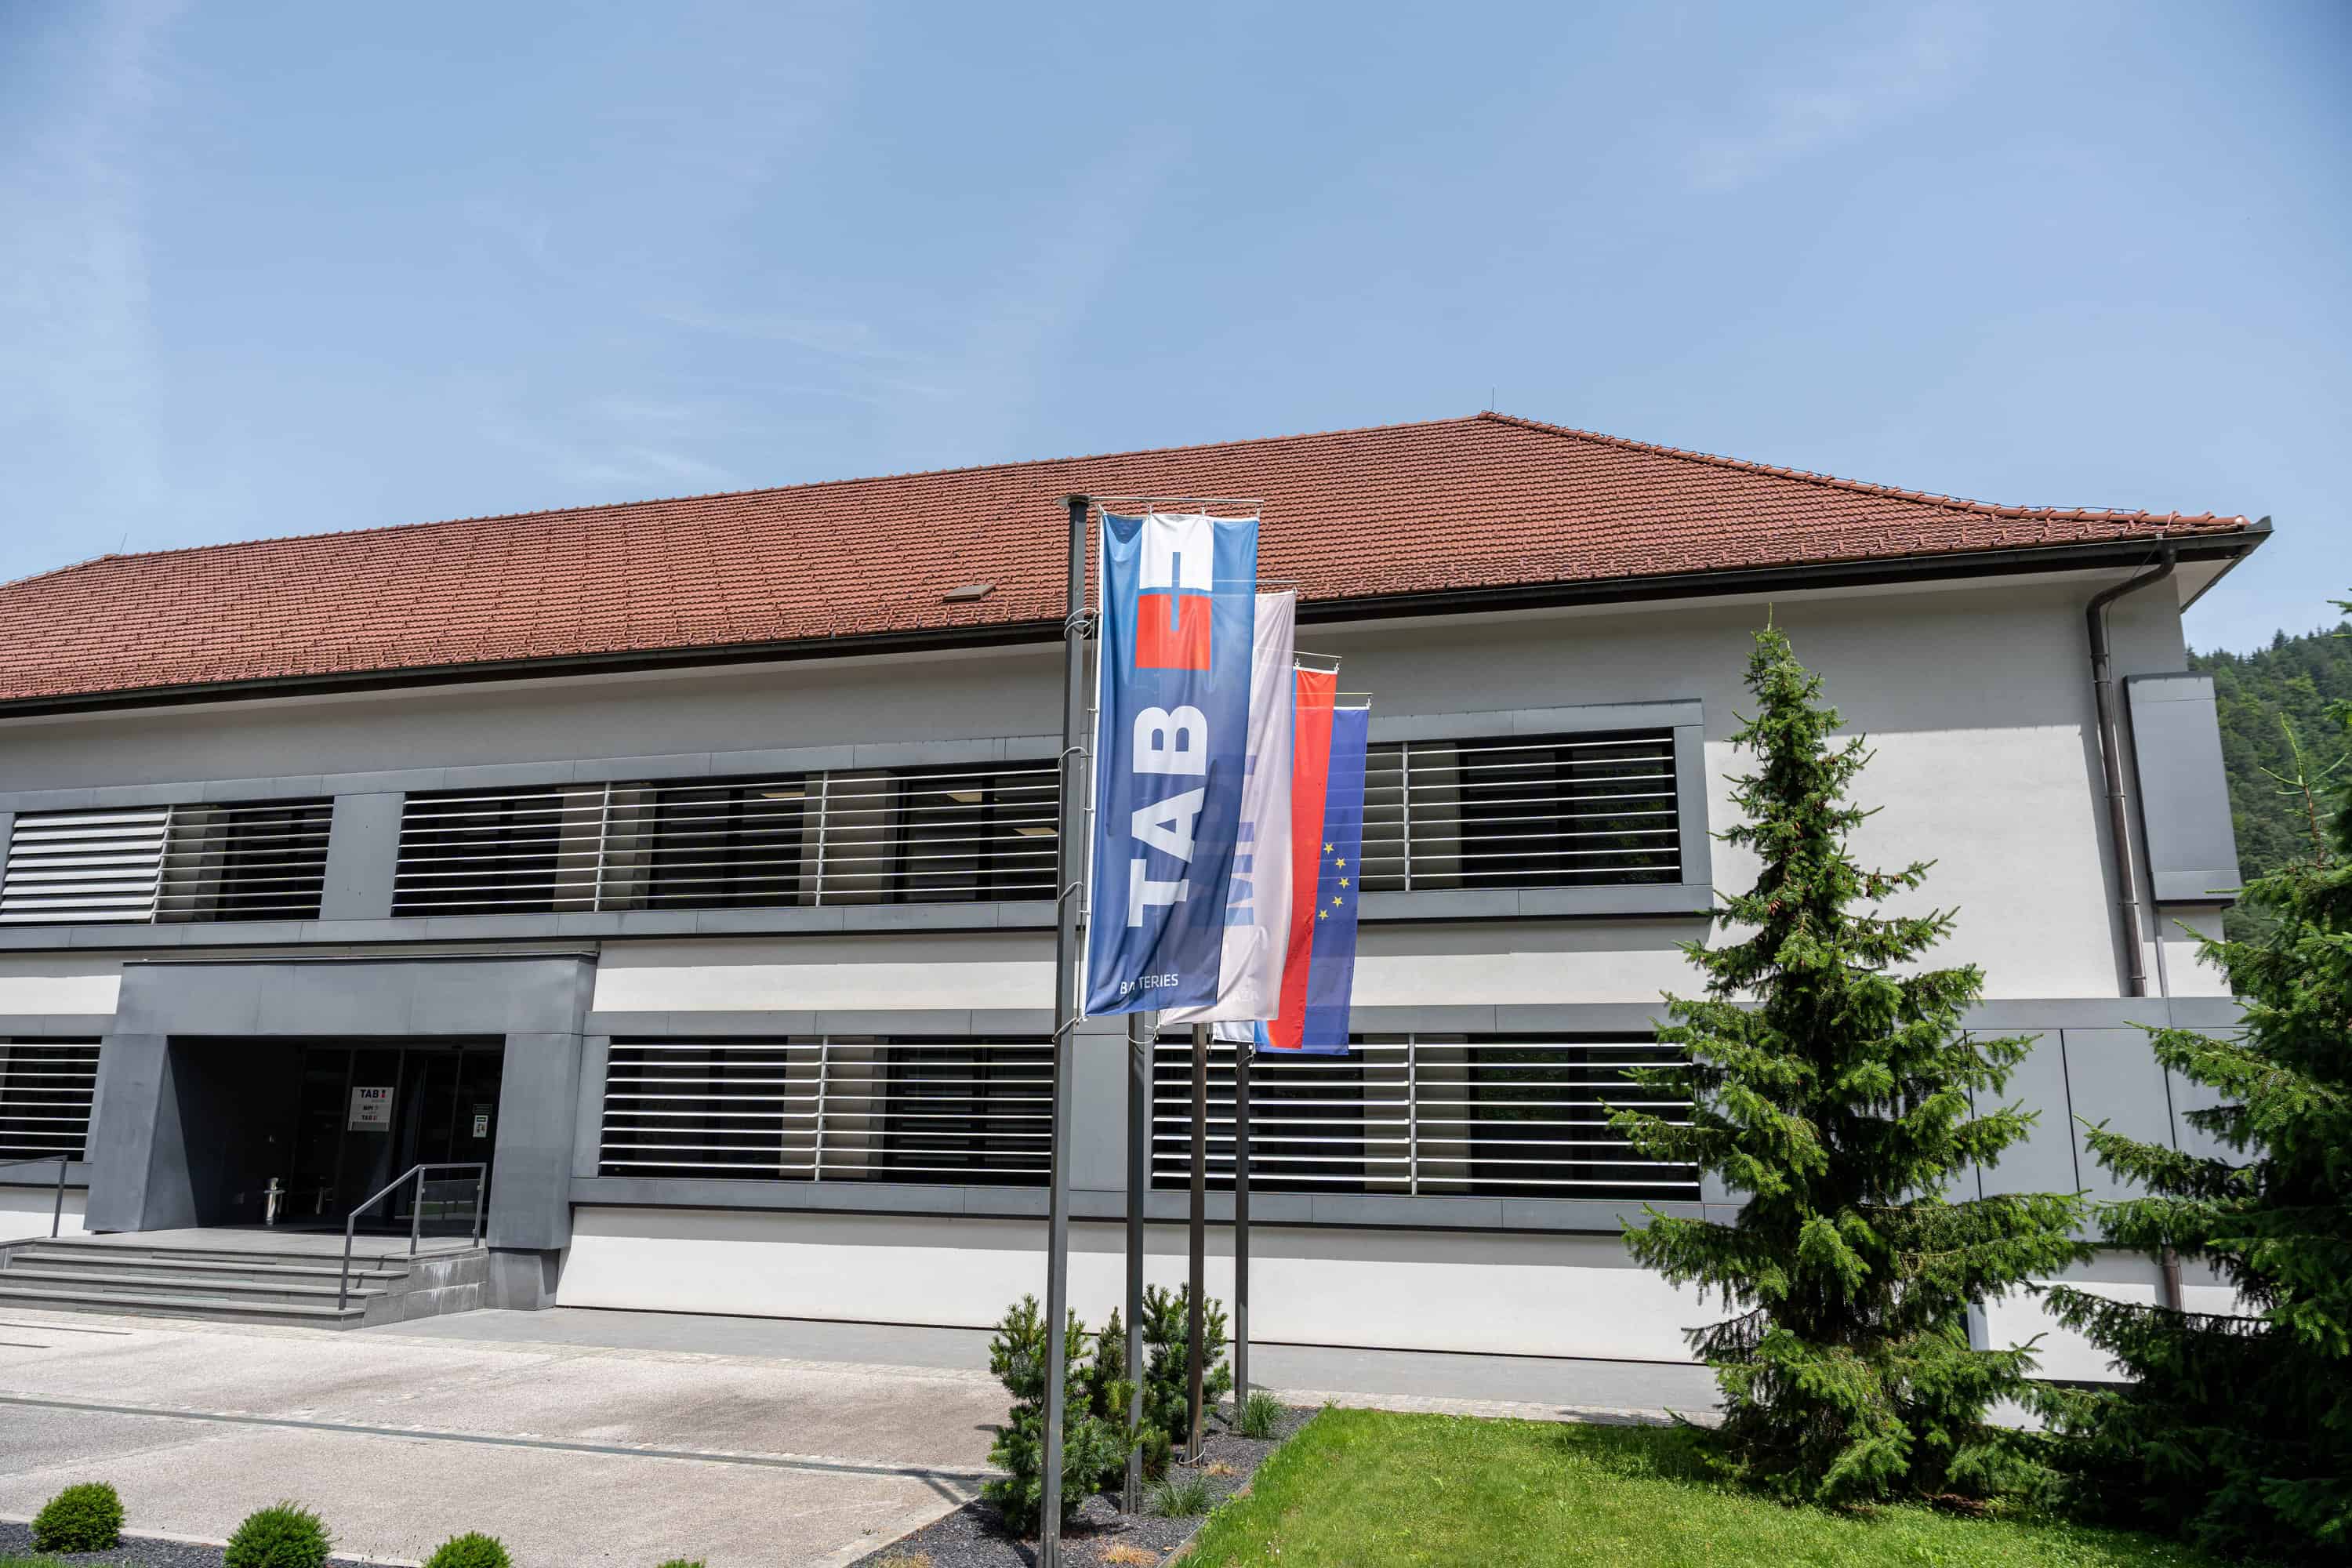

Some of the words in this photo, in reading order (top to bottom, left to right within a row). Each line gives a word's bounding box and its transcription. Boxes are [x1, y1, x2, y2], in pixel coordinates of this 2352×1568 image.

[1127, 706, 1207, 927] TAB
[1120, 974, 1179, 995] BATERIES
[361, 1089, 379, 1098] TAB
